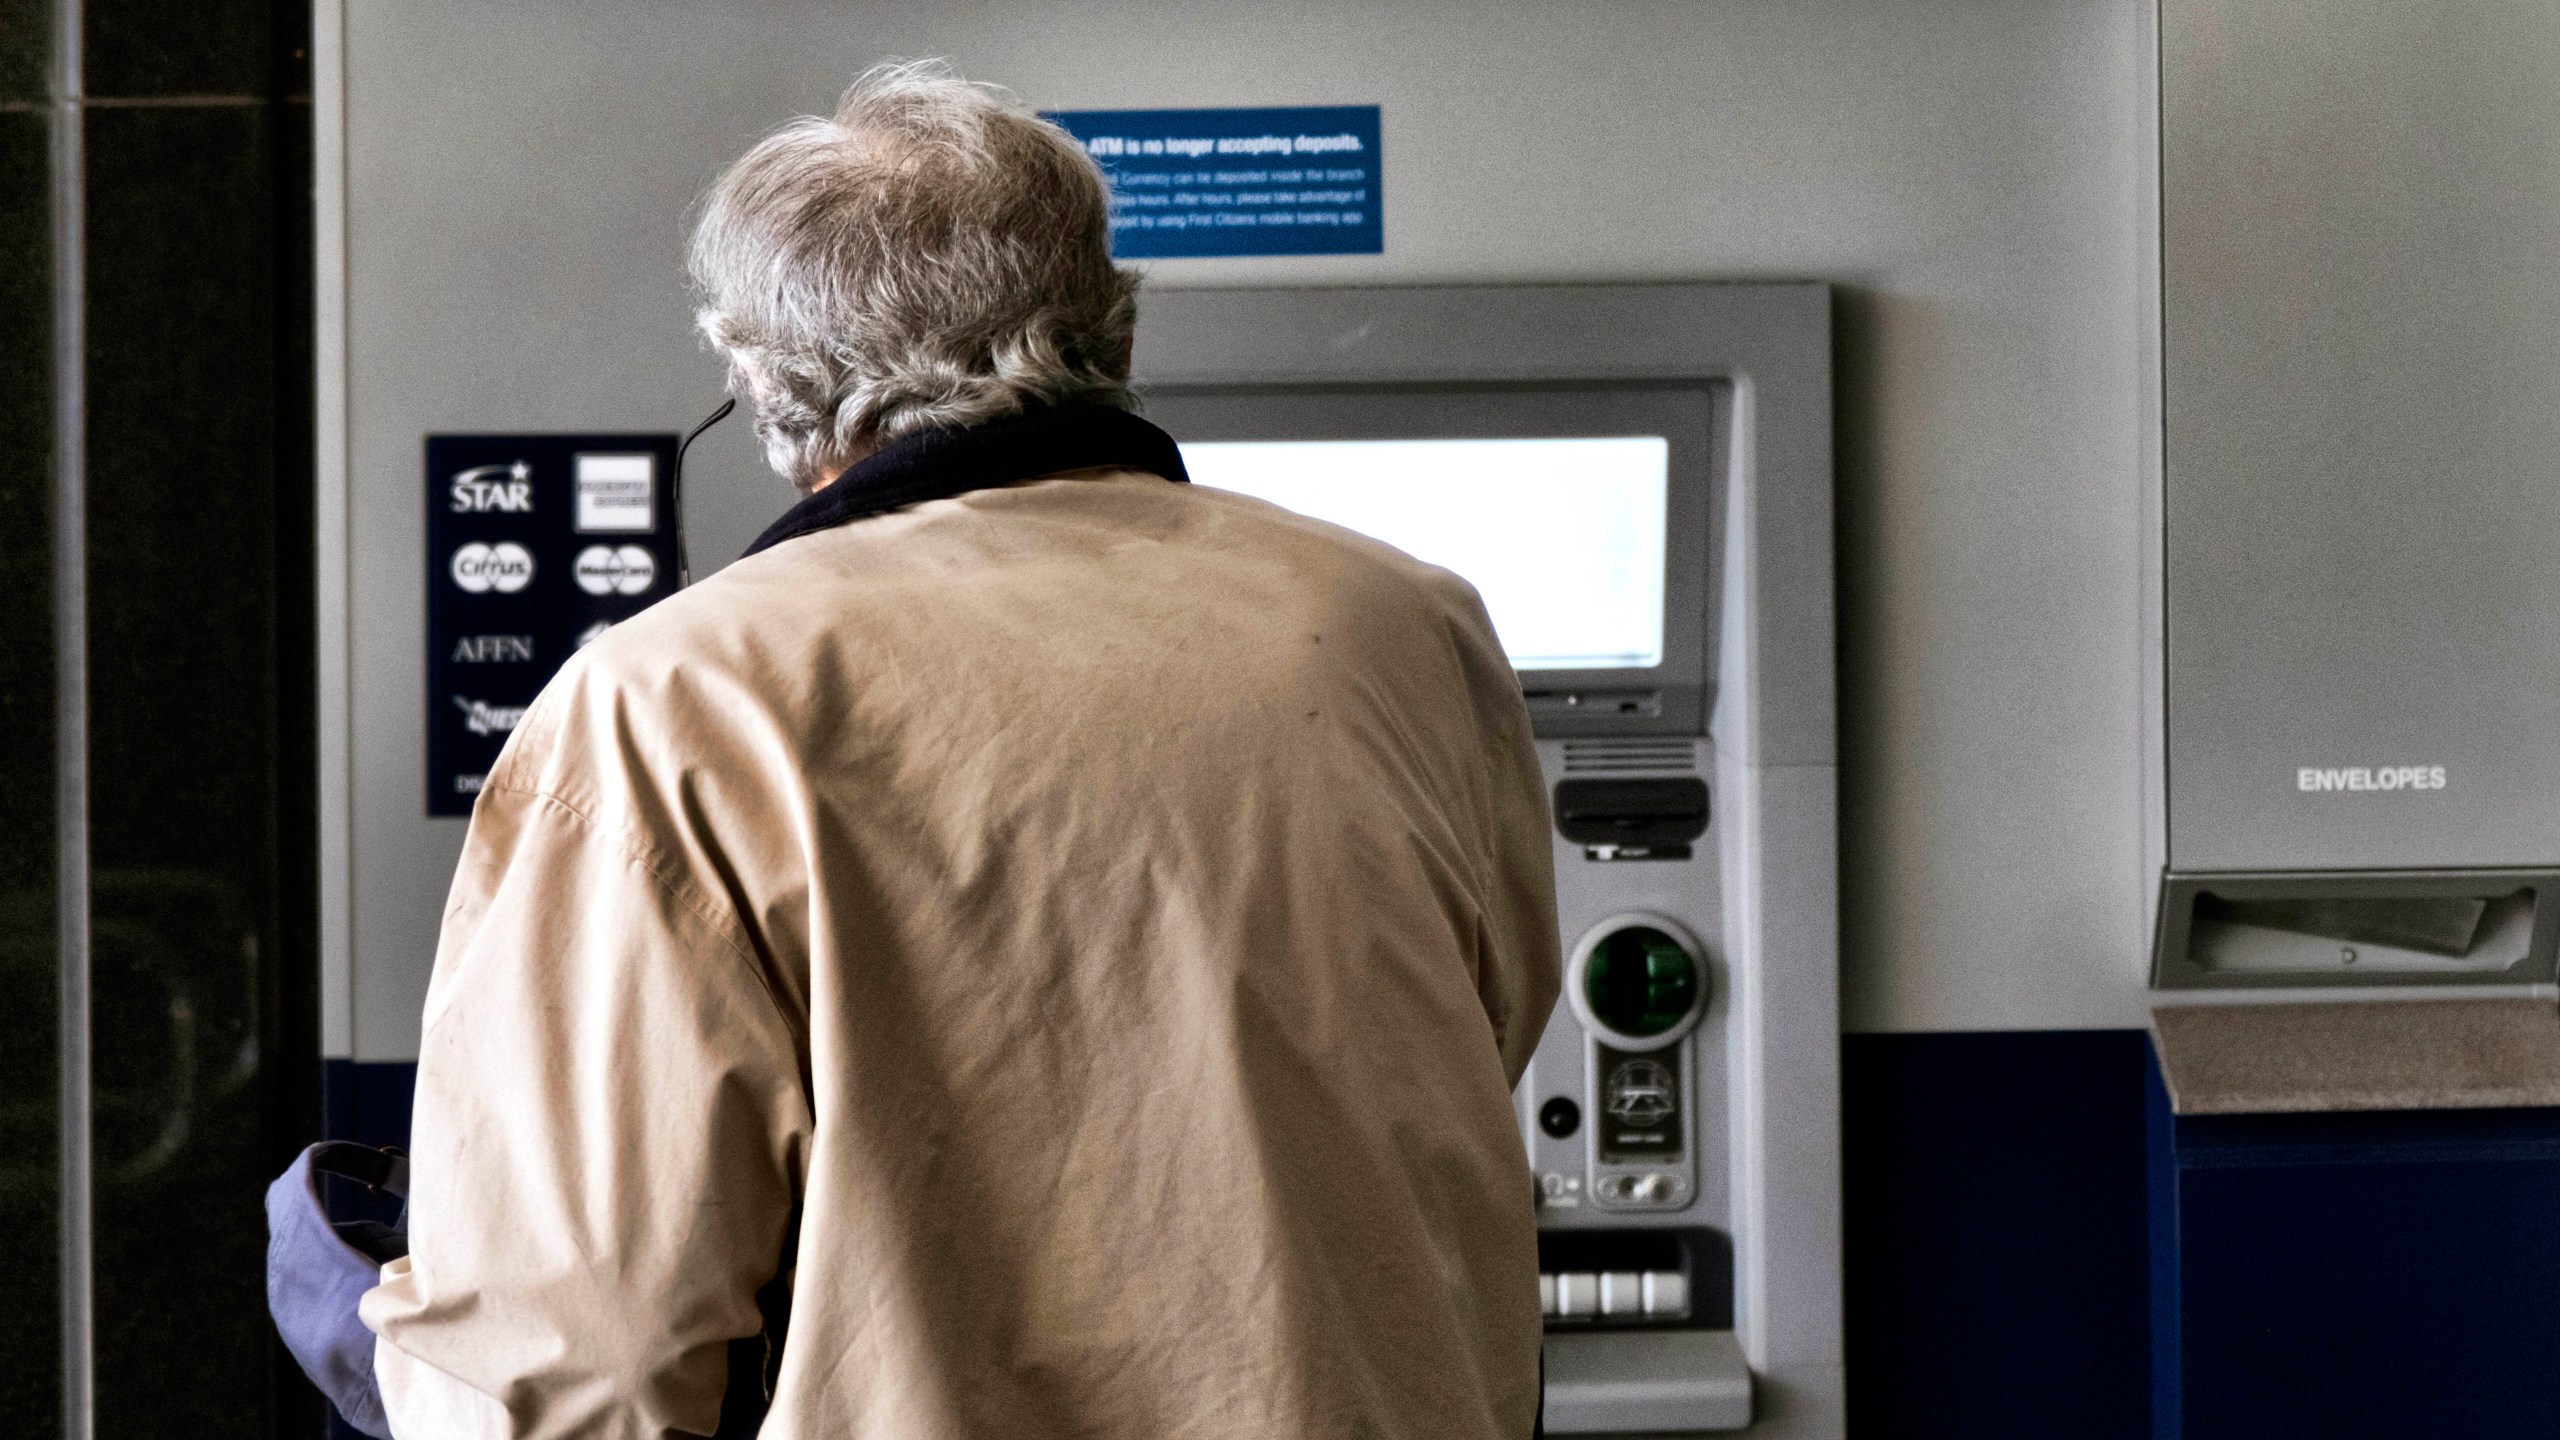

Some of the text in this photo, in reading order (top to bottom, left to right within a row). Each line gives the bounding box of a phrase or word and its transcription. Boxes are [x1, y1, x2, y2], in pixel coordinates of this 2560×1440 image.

[1089, 137, 1123, 154] ATM
[1125, 139, 1140, 154] is
[1142, 140, 1164, 154] no
[1165, 137, 1214, 157] longer
[1217, 135, 1292, 156] accepting
[1294, 133, 1364, 154] deposits.
[1120, 172, 1170, 186] Currency
[1214, 170, 1267, 184] deposited
[452, 482, 533, 513] STAR
[459, 558, 526, 577] Cirrus
[453, 635, 534, 664] AFFN
[2298, 767, 2446, 791] ENVELOPES
